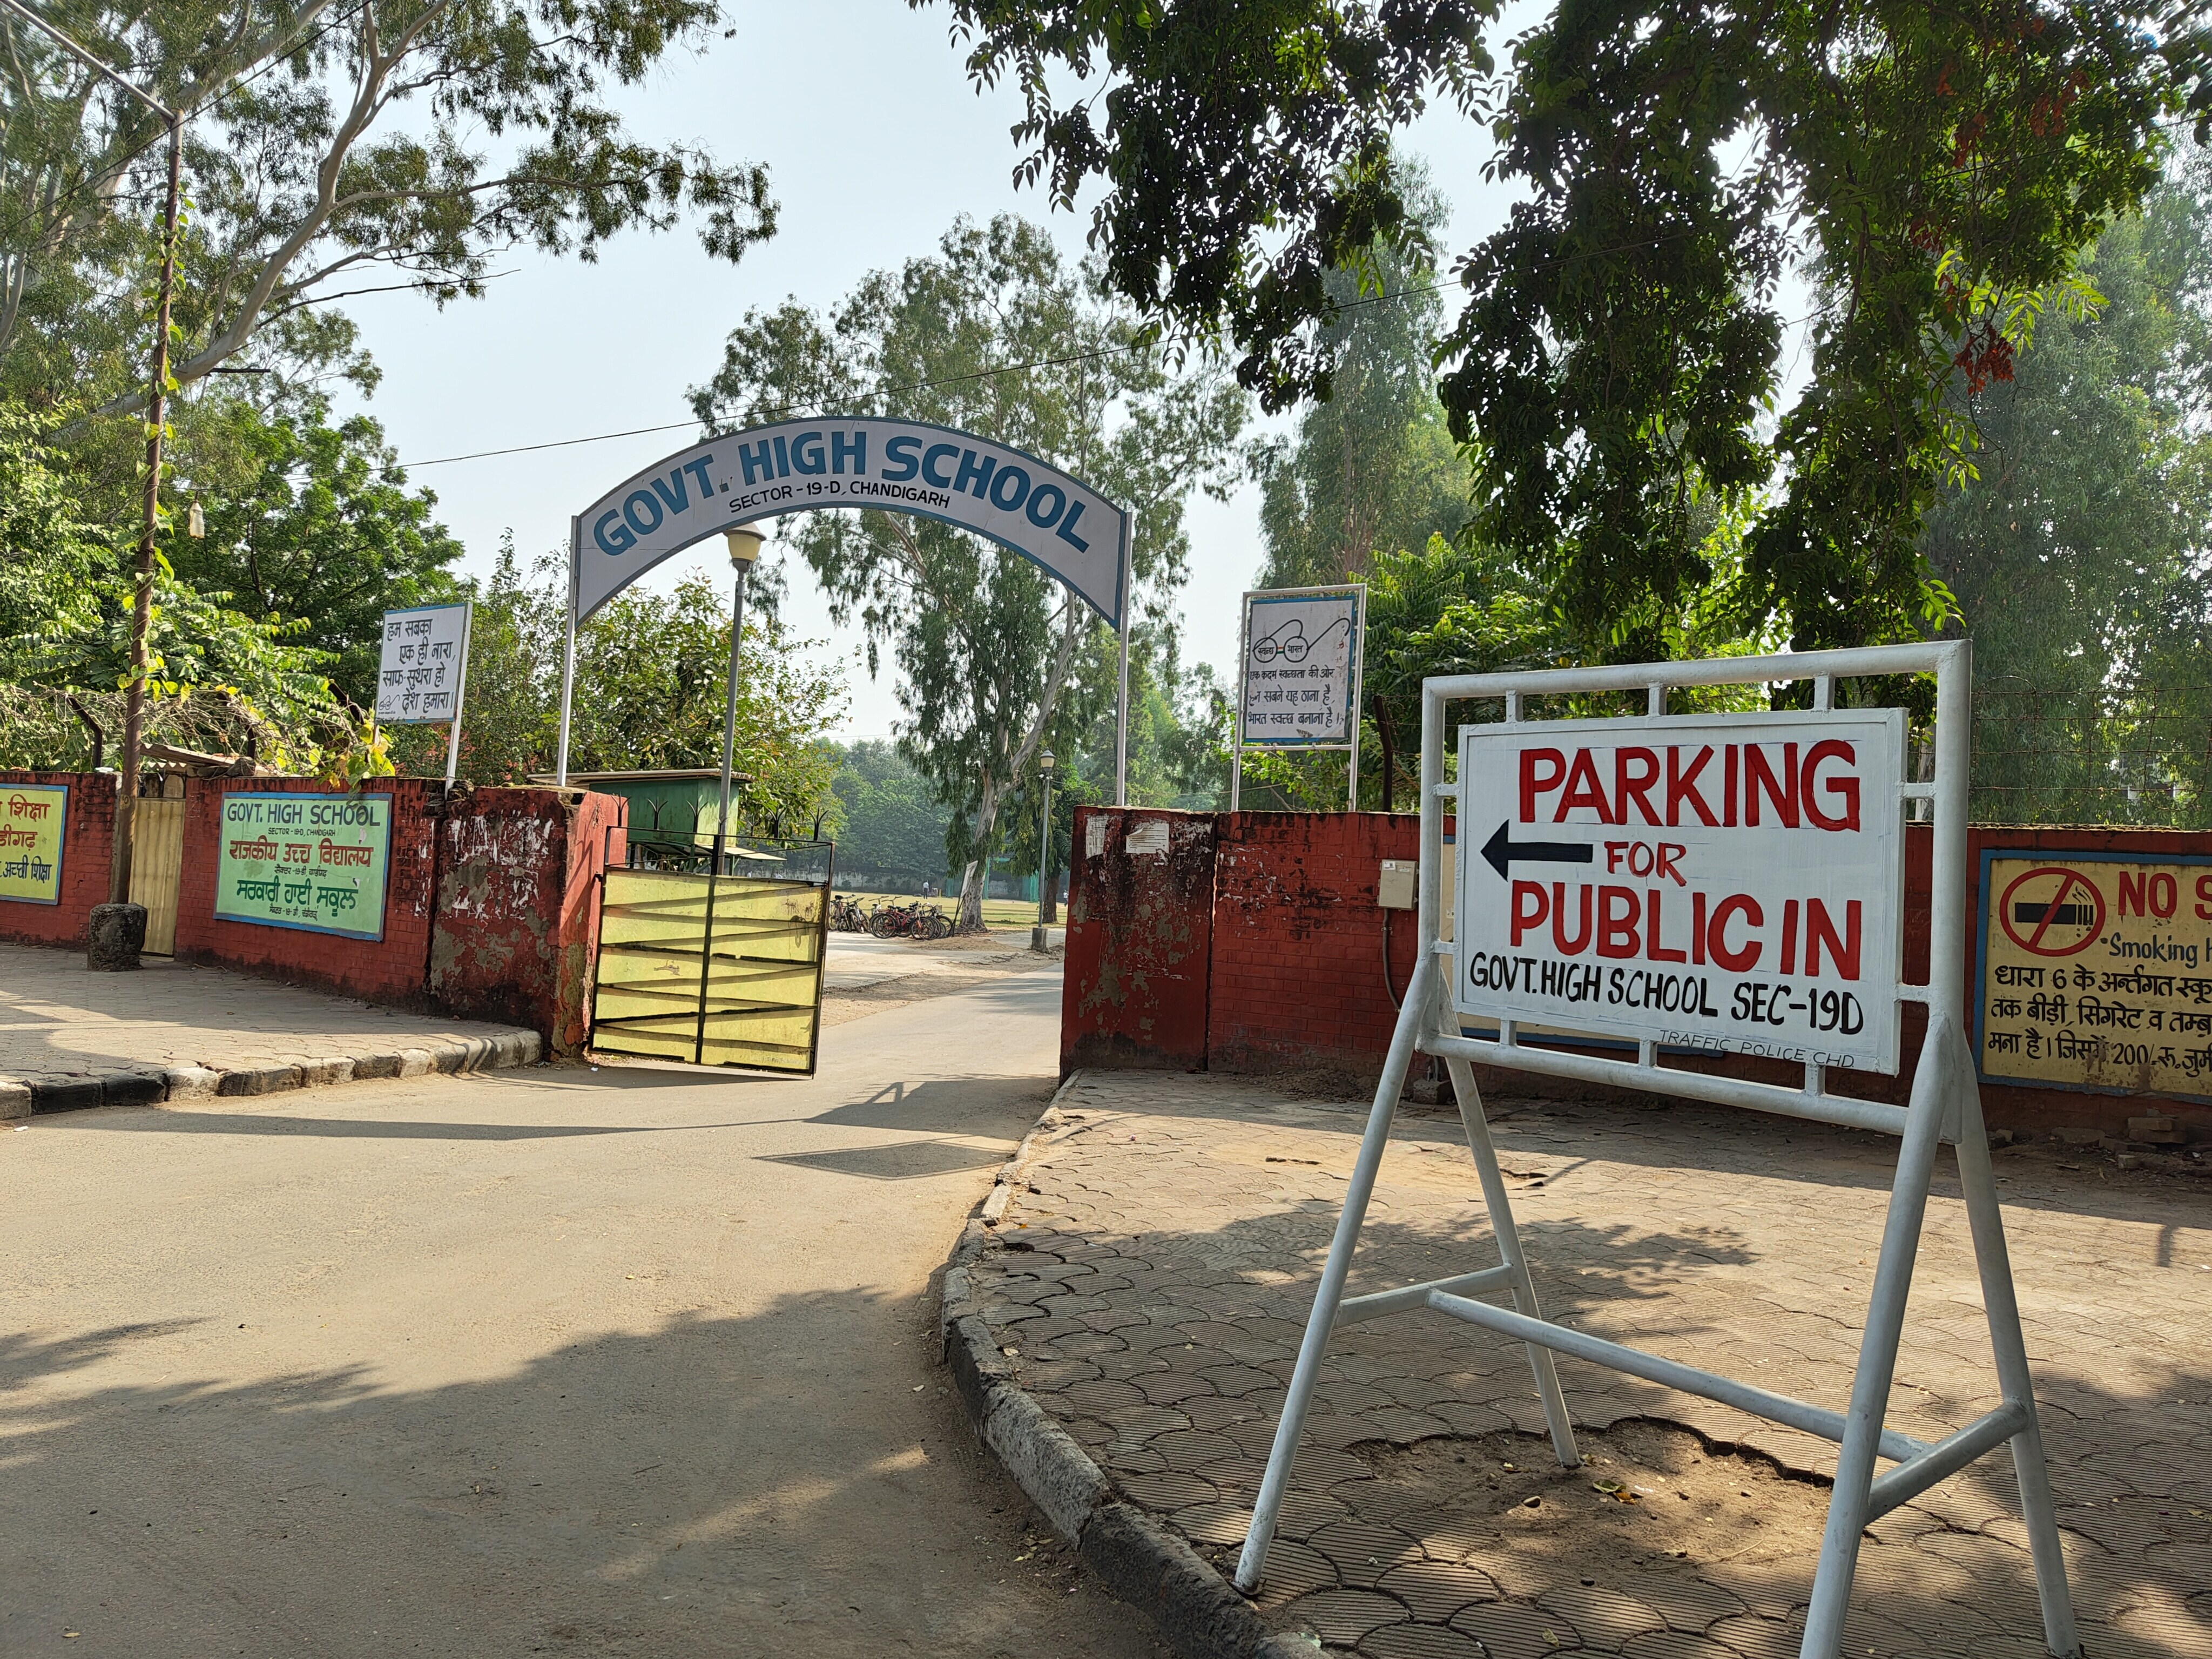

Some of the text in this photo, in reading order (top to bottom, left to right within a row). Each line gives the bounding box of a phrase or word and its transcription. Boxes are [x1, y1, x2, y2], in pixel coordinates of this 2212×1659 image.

[592, 431, 1090, 556] GOVT. HIGH SCHOOL
[849, 481, 951, 509] CHANDIGARH
[387, 619, 433, 641] हम सबका
[399, 645, 414, 664] एक
[417, 636, 429, 665] ही
[1287, 645, 1304, 653] भारत
[434, 662, 446, 688] हो
[1250, 671, 1260, 680] एक
[1262, 670, 1277, 682] कदम
[1308, 665, 1319, 679] की
[1319, 665, 1335, 678] ओर
[402, 687, 421, 714] देश
[1264, 684, 1284, 703] सबने
[1286, 690, 1299, 706] यह
[1301, 690, 1320, 703] ठाना
[1248, 711, 1267, 725] भारत
[1298, 712, 1325, 725] बनाना
[1519, 739, 1860, 832] PARKING
[8, 794, 51, 822] शिक्षा
[227, 803, 381, 826] GOVT. HIGH SCHOOL
[230, 835, 374, 867] राजकीय उच्च विद्यालय
[1604, 841, 1687, 887] FOR
[31, 855, 52, 884] शिक्षा
[237, 875, 359, 917] ਸਰਕਾਰੀ ਹਾਈ ਸਕੂਲ
[2118, 871, 2177, 918] NO
[1510, 880, 1862, 981] PUBLIC IN
[2109, 932, 2198, 969] Smoking
[1995, 965, 2046, 988] धारा
[2052, 969, 2067, 989] 6
[2073, 963, 2095, 990] के
[1608, 968, 1718, 1017] SCHOOL
[1731, 982, 1864, 1035] SEC-19D
[1991, 998, 2022, 1019] तक
[2076, 996, 2144, 1029] सिगरेट
[2149, 1010, 2167, 1031] व
[1660, 1029, 1731, 1050] TRAFFIC
[1741, 1042, 1806, 1061] POLICE
[1988, 1032, 2022, 1053] मना
